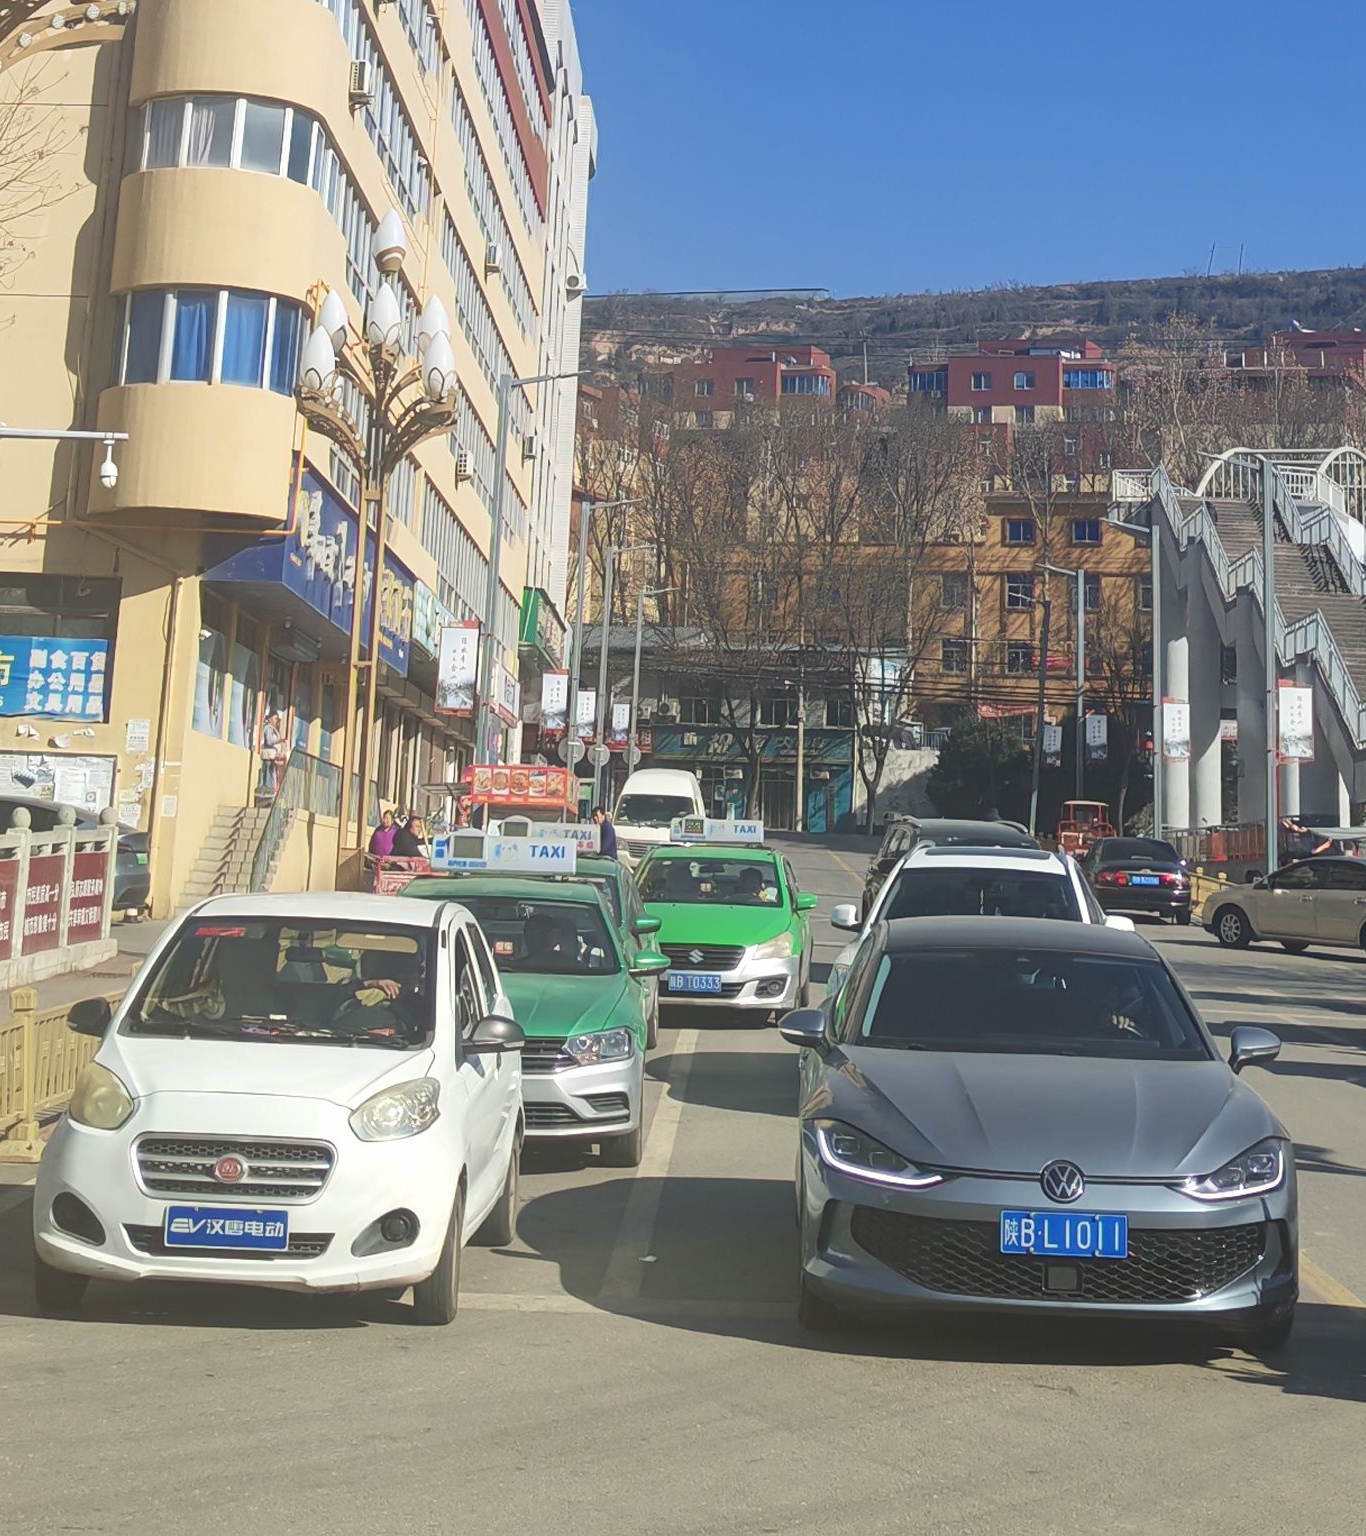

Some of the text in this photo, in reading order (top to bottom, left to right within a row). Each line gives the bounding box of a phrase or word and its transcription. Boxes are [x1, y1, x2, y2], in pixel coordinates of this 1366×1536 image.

[562, 829, 592, 840] TAXI
[733, 825, 757, 834] TAXI
[529, 845, 566, 859] TAXI
